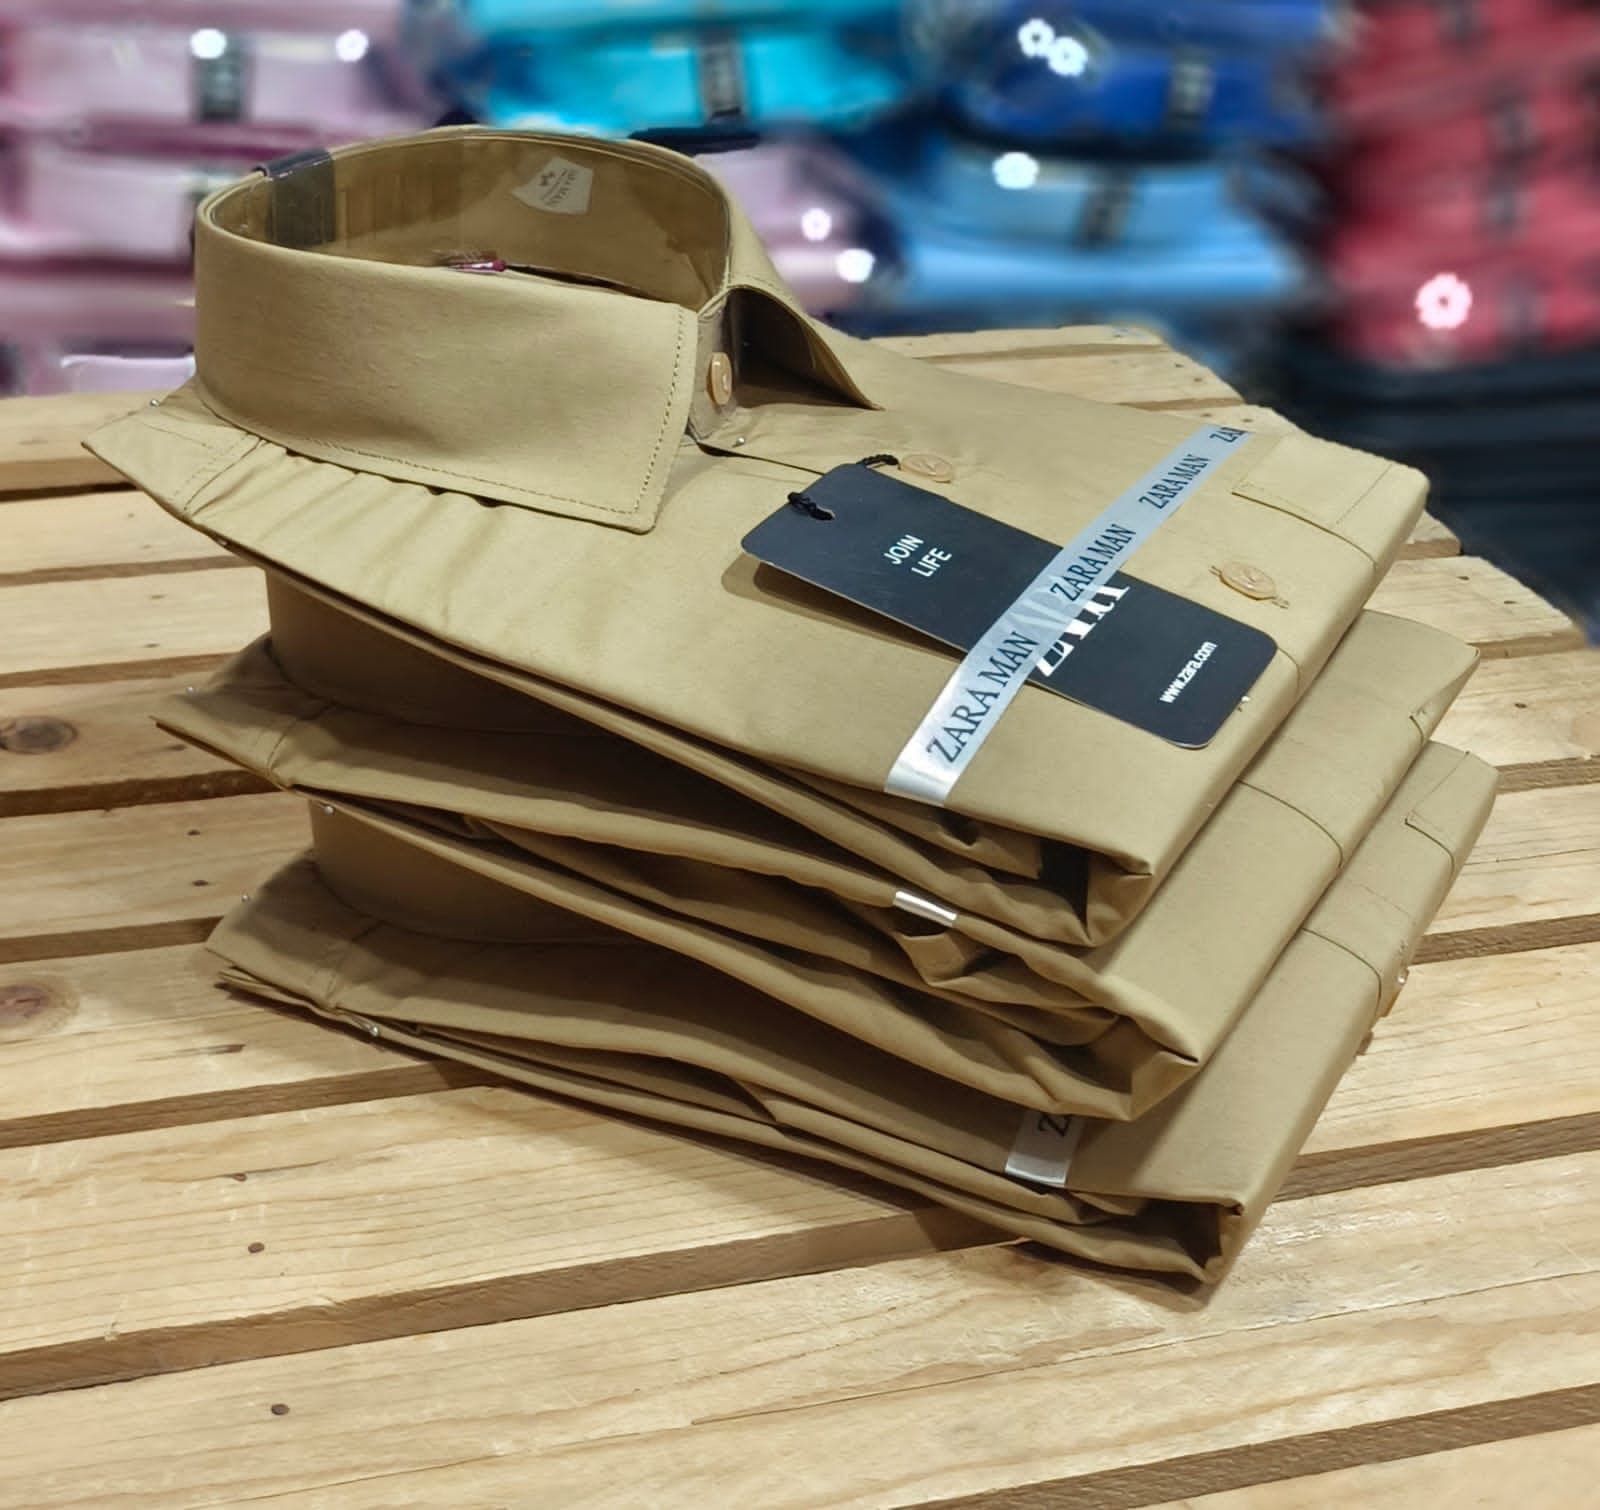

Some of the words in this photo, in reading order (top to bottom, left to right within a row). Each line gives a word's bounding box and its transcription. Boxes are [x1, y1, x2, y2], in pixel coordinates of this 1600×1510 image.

[1138, 478, 1188, 509] ZARA
[1167, 454, 1210, 480] MAN
[883, 534, 924, 564] JOIN
[911, 548, 952, 577] LIFE
[1050, 555, 1108, 601] ZARA
[1087, 523, 1137, 560] MAN
[926, 688, 1001, 763] ZARA
[977, 631, 1040, 688] MAN
[1159, 641, 1218, 703] www.zara.com
